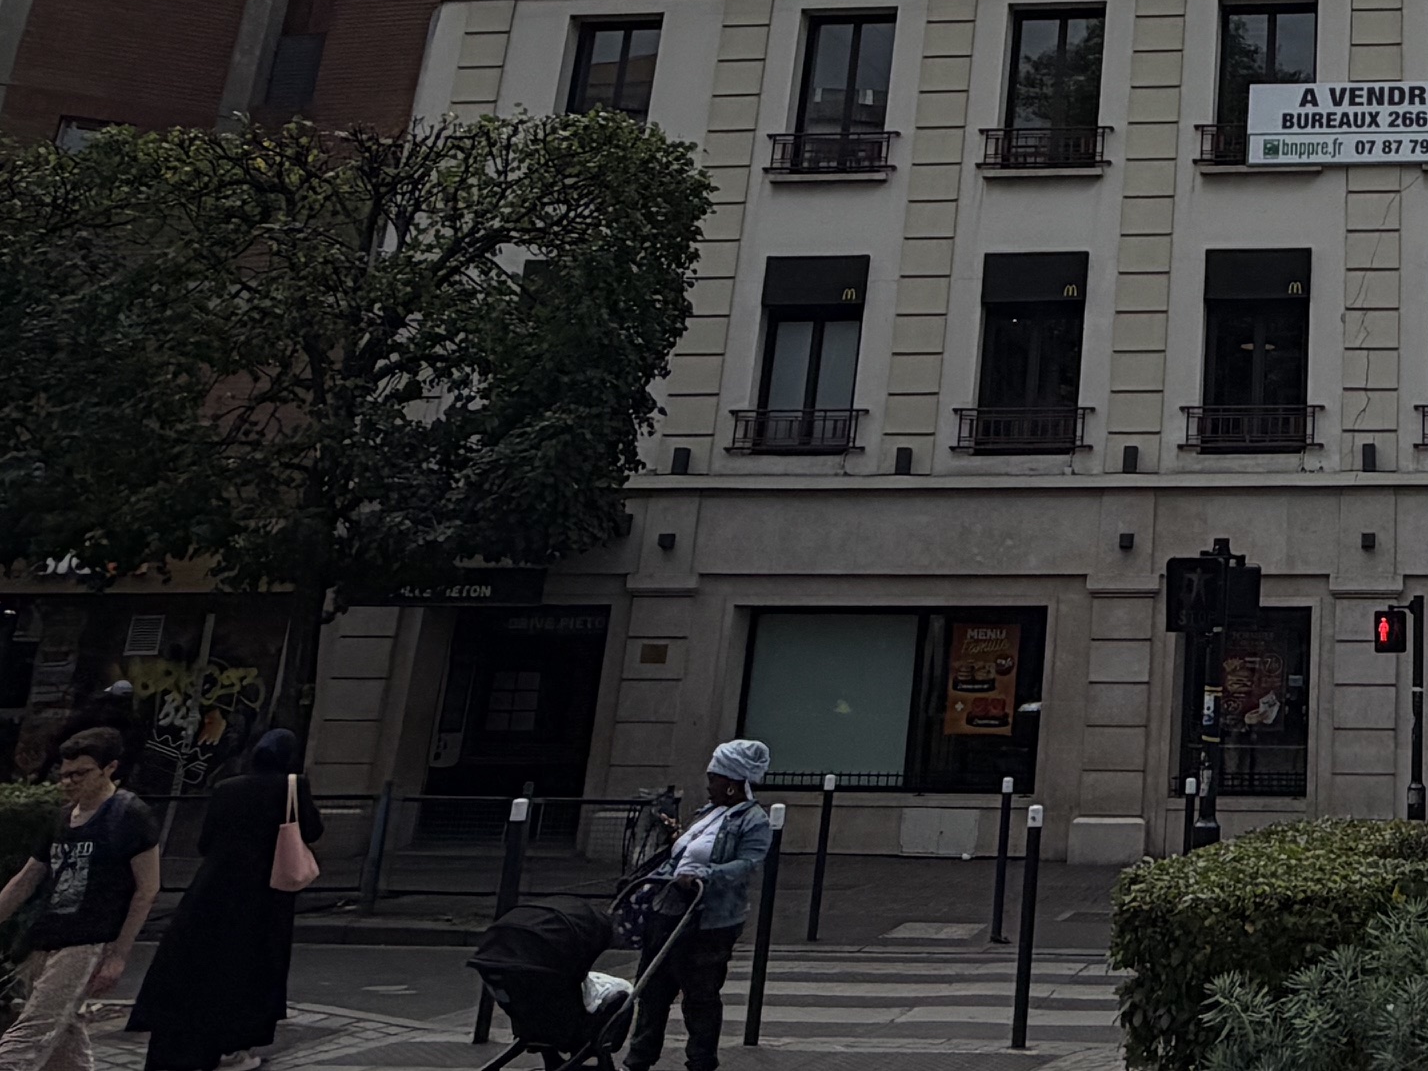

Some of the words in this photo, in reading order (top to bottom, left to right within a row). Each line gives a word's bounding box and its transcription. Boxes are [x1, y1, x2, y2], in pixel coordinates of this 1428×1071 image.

[1299, 87, 1320, 108] A
[1281, 111, 1381, 130] BUREAUX
[1387, 110, 1428, 128] 266
[1282, 137, 1344, 159] bnppre.fr
[1354, 139, 1376, 156] 07
[1381, 139, 1403, 155] 87
[966, 628, 1007, 640] MENU
